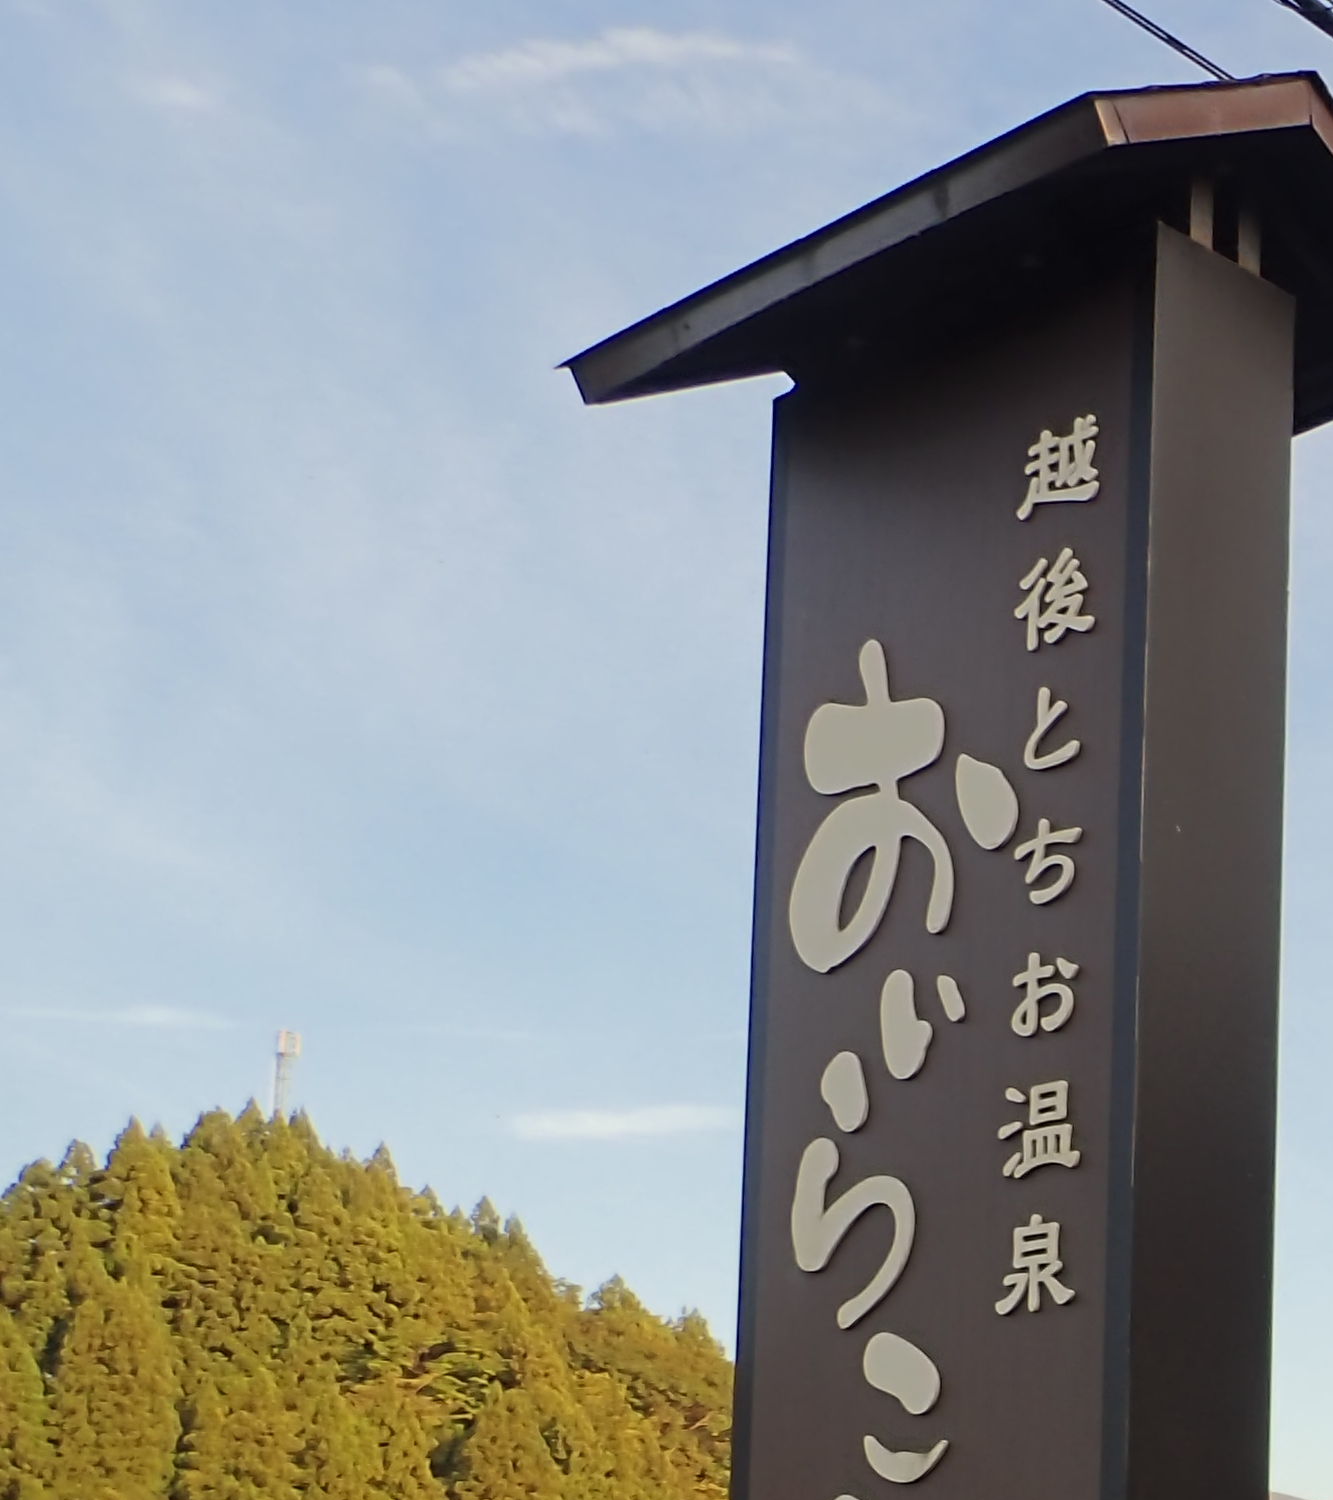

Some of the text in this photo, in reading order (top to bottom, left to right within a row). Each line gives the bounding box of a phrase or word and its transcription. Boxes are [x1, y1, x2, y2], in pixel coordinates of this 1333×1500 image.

[994, 414, 1100, 1316] 越後とちお温泉
